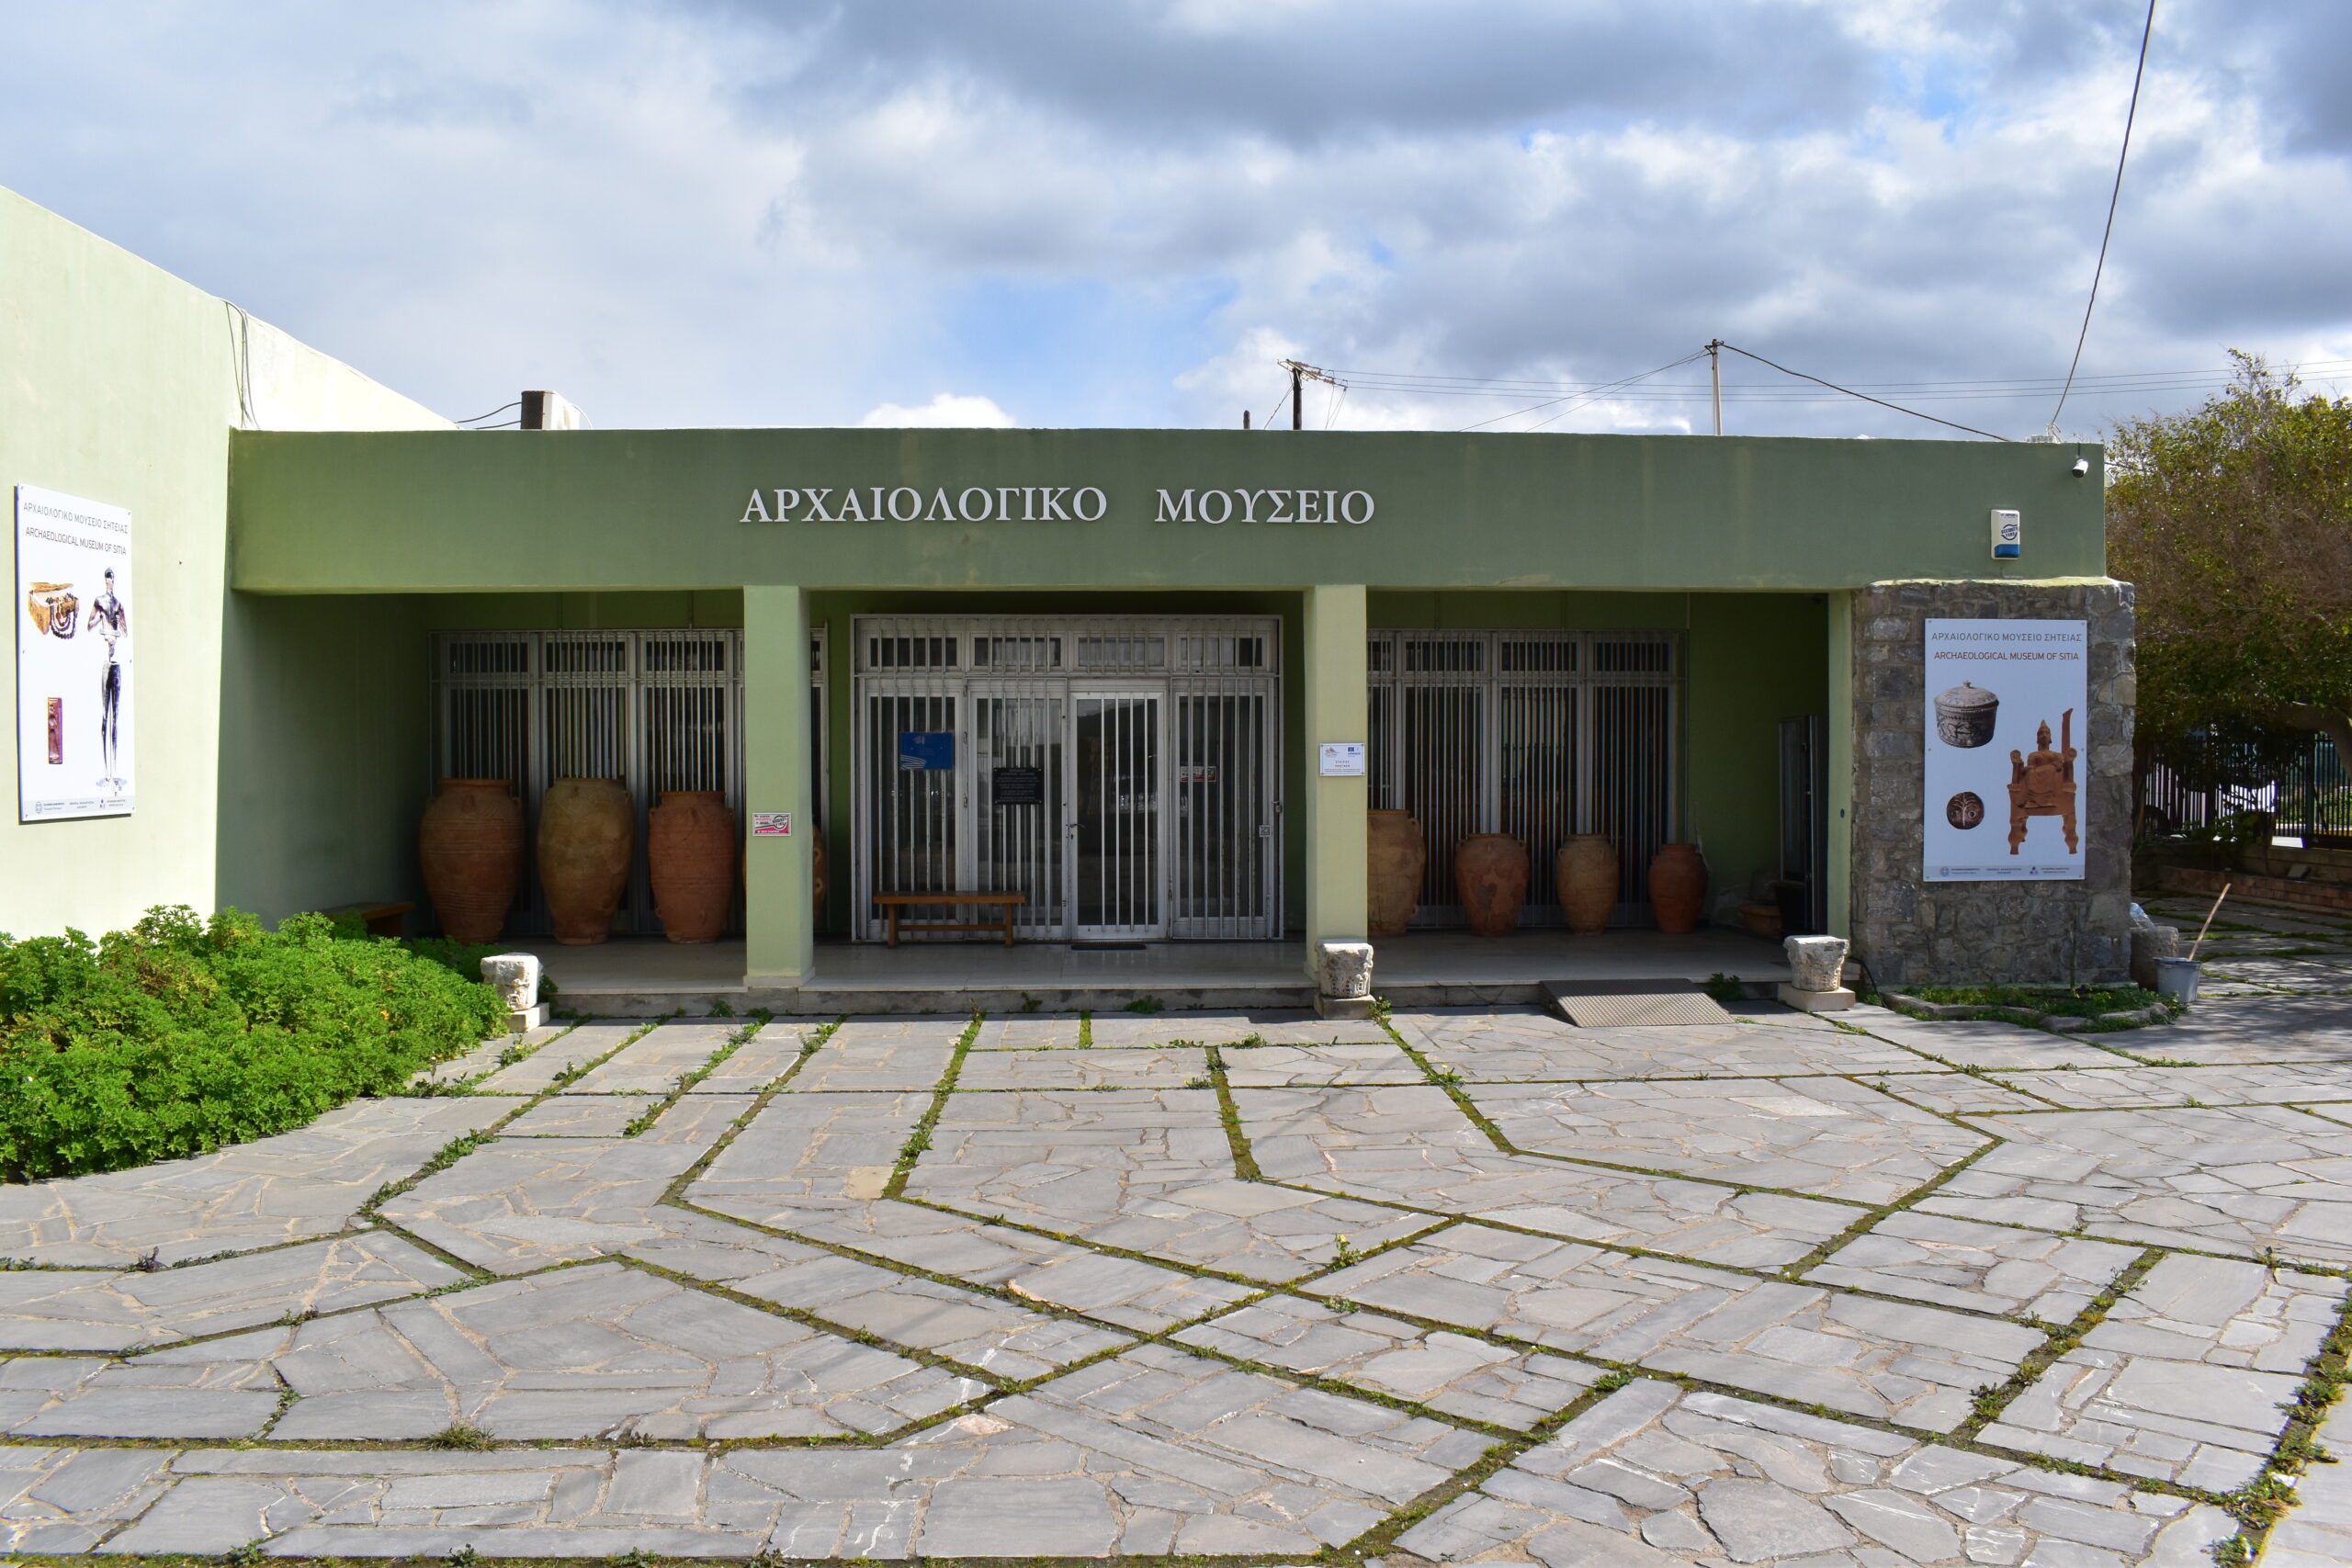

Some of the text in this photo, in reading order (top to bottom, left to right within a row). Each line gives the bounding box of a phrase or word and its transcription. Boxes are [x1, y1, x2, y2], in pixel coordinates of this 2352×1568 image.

[24, 502, 128, 535] ΑΡΧΑΙΟΛΟΓΙΚΟ ΜΟΥΣΕΙΟ ΣΗΤΕΙΑΣ
[740, 487, 1374, 524] ΑΡΧΑΙΟΛΟΓΙΚΟ ΜΟΥΣΕΙΟ
[26, 526, 127, 556] ARCHAEOLOGICAL MUSEUM OF SITIA
[1931, 632, 2082, 642] ΑΡΧΑΙΟΛΟΓΙΚΟ ΜΟΥΣΕΙΟ ΣΗΤΕΙΑΣ
[1934, 651, 2079, 660] ARCHAEOLOGICAL MUSEUM OF SITIA
